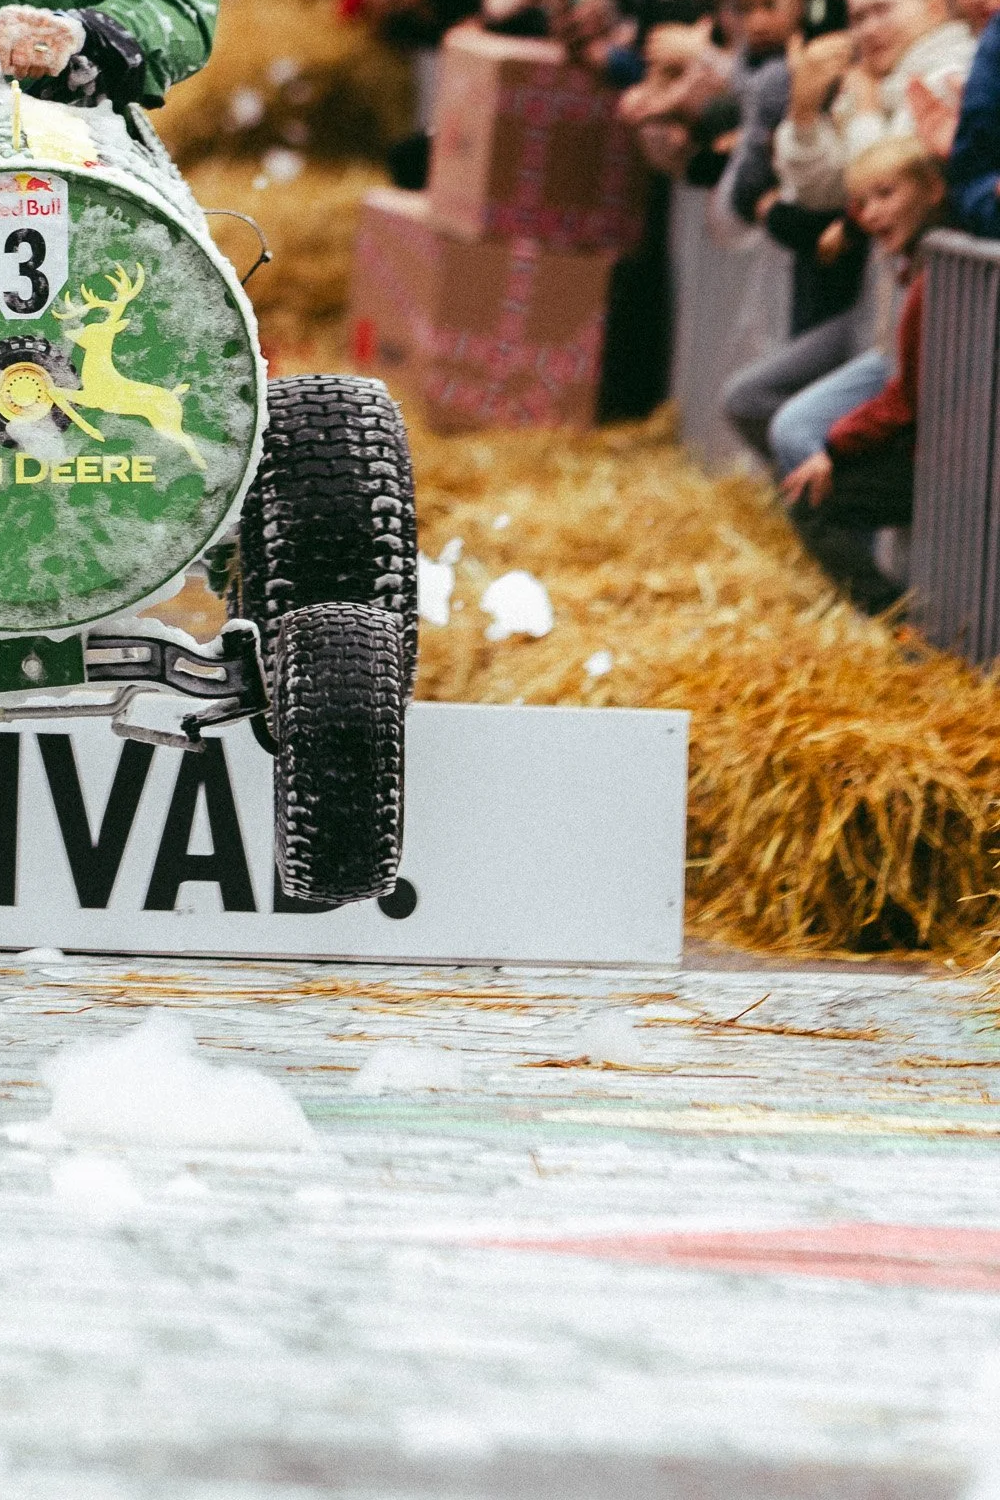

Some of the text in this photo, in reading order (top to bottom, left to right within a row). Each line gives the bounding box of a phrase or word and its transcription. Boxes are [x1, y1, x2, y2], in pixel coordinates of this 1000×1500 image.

[26, 199, 62, 217] Bull
[3, 228, 50, 315] 3
[15, 452, 157, 485] DEERE
